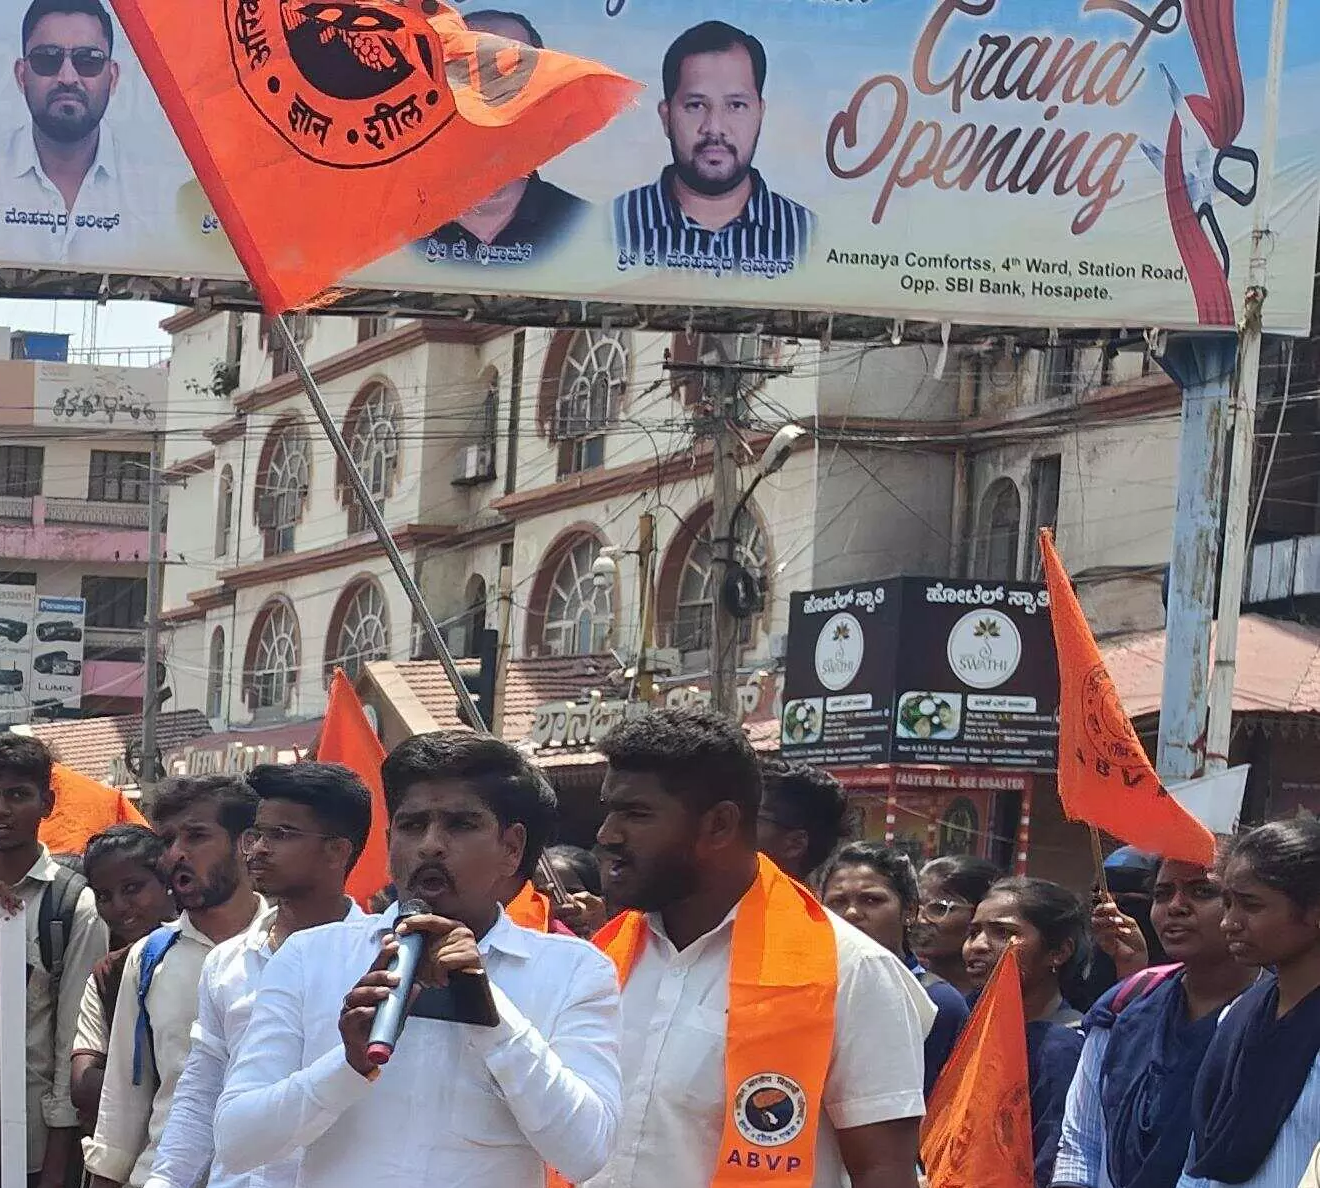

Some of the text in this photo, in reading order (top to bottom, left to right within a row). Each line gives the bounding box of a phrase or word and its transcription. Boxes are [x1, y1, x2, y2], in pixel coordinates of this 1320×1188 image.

[912, 0, 1180, 114] Grand
[289, 93, 333, 147] ज्ञान
[363, 93, 423, 150] शील
[826, 76, 1140, 235] Opening
[826, 249, 1188, 283] Ananaya Comfortss, 4th Ward, Station Road,
[900, 276, 1112, 302] Opp. SBI Bank, Hosapete.
[926, 583, 1004, 605] ಹೋಟೆಲ್
[822, 658, 854, 675] SWATHI
[960, 658, 1007, 672] SWATHI
[38, 682, 72, 692] LUMIX
[727, 1149, 801, 1172] ABVP
